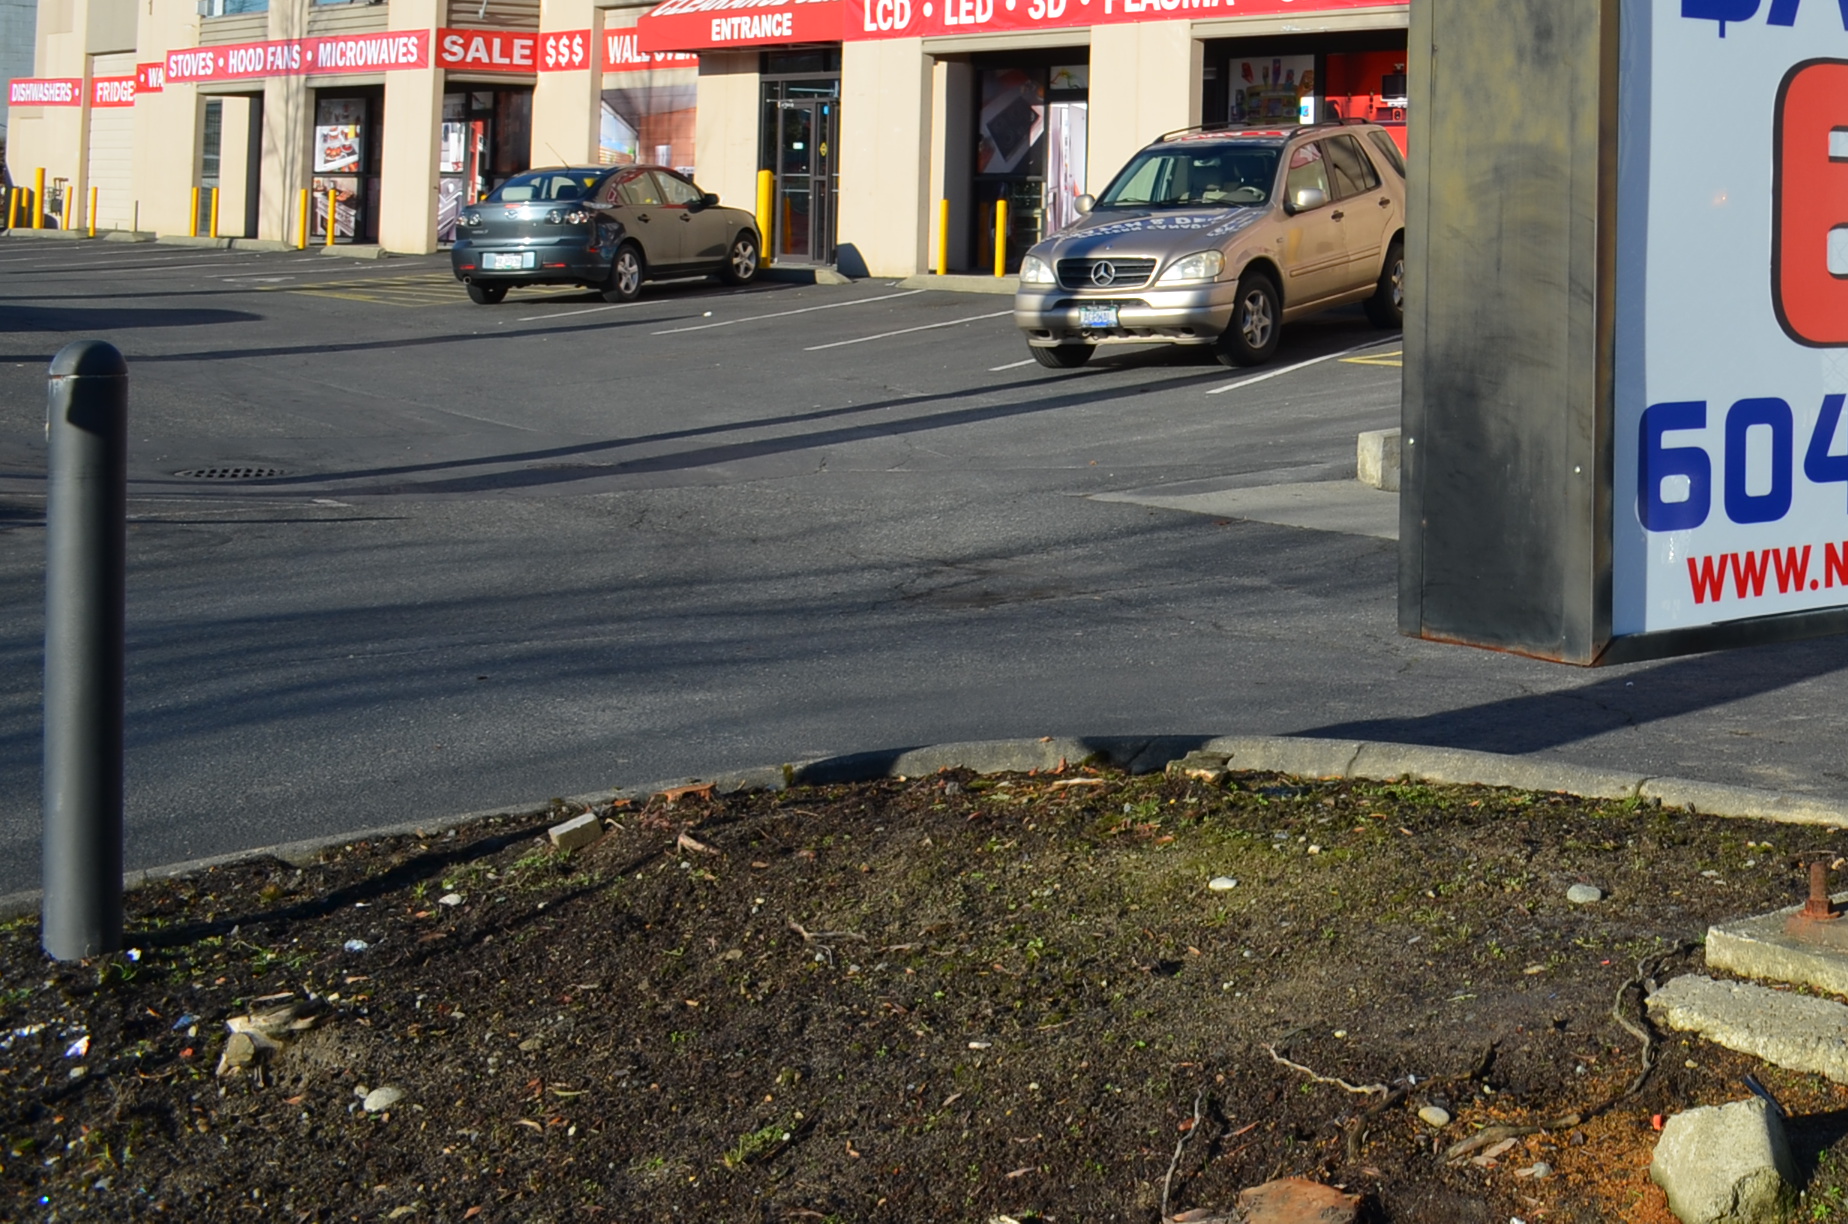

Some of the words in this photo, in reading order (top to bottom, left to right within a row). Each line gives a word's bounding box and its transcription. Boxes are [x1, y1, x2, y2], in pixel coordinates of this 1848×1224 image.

[711, 12, 793, 42] ENTRANCE
[168, 51, 214, 78] STOVES
[228, 47, 264, 74] HOOD
[266, 44, 301, 71] FANS
[317, 36, 419, 68] MICROWAVES
[441, 34, 535, 66] SALE
[545, 33, 584, 68] $$$
[11, 82, 73, 102] DISHWASHERS
[96, 80, 135, 103] FRIDGE
